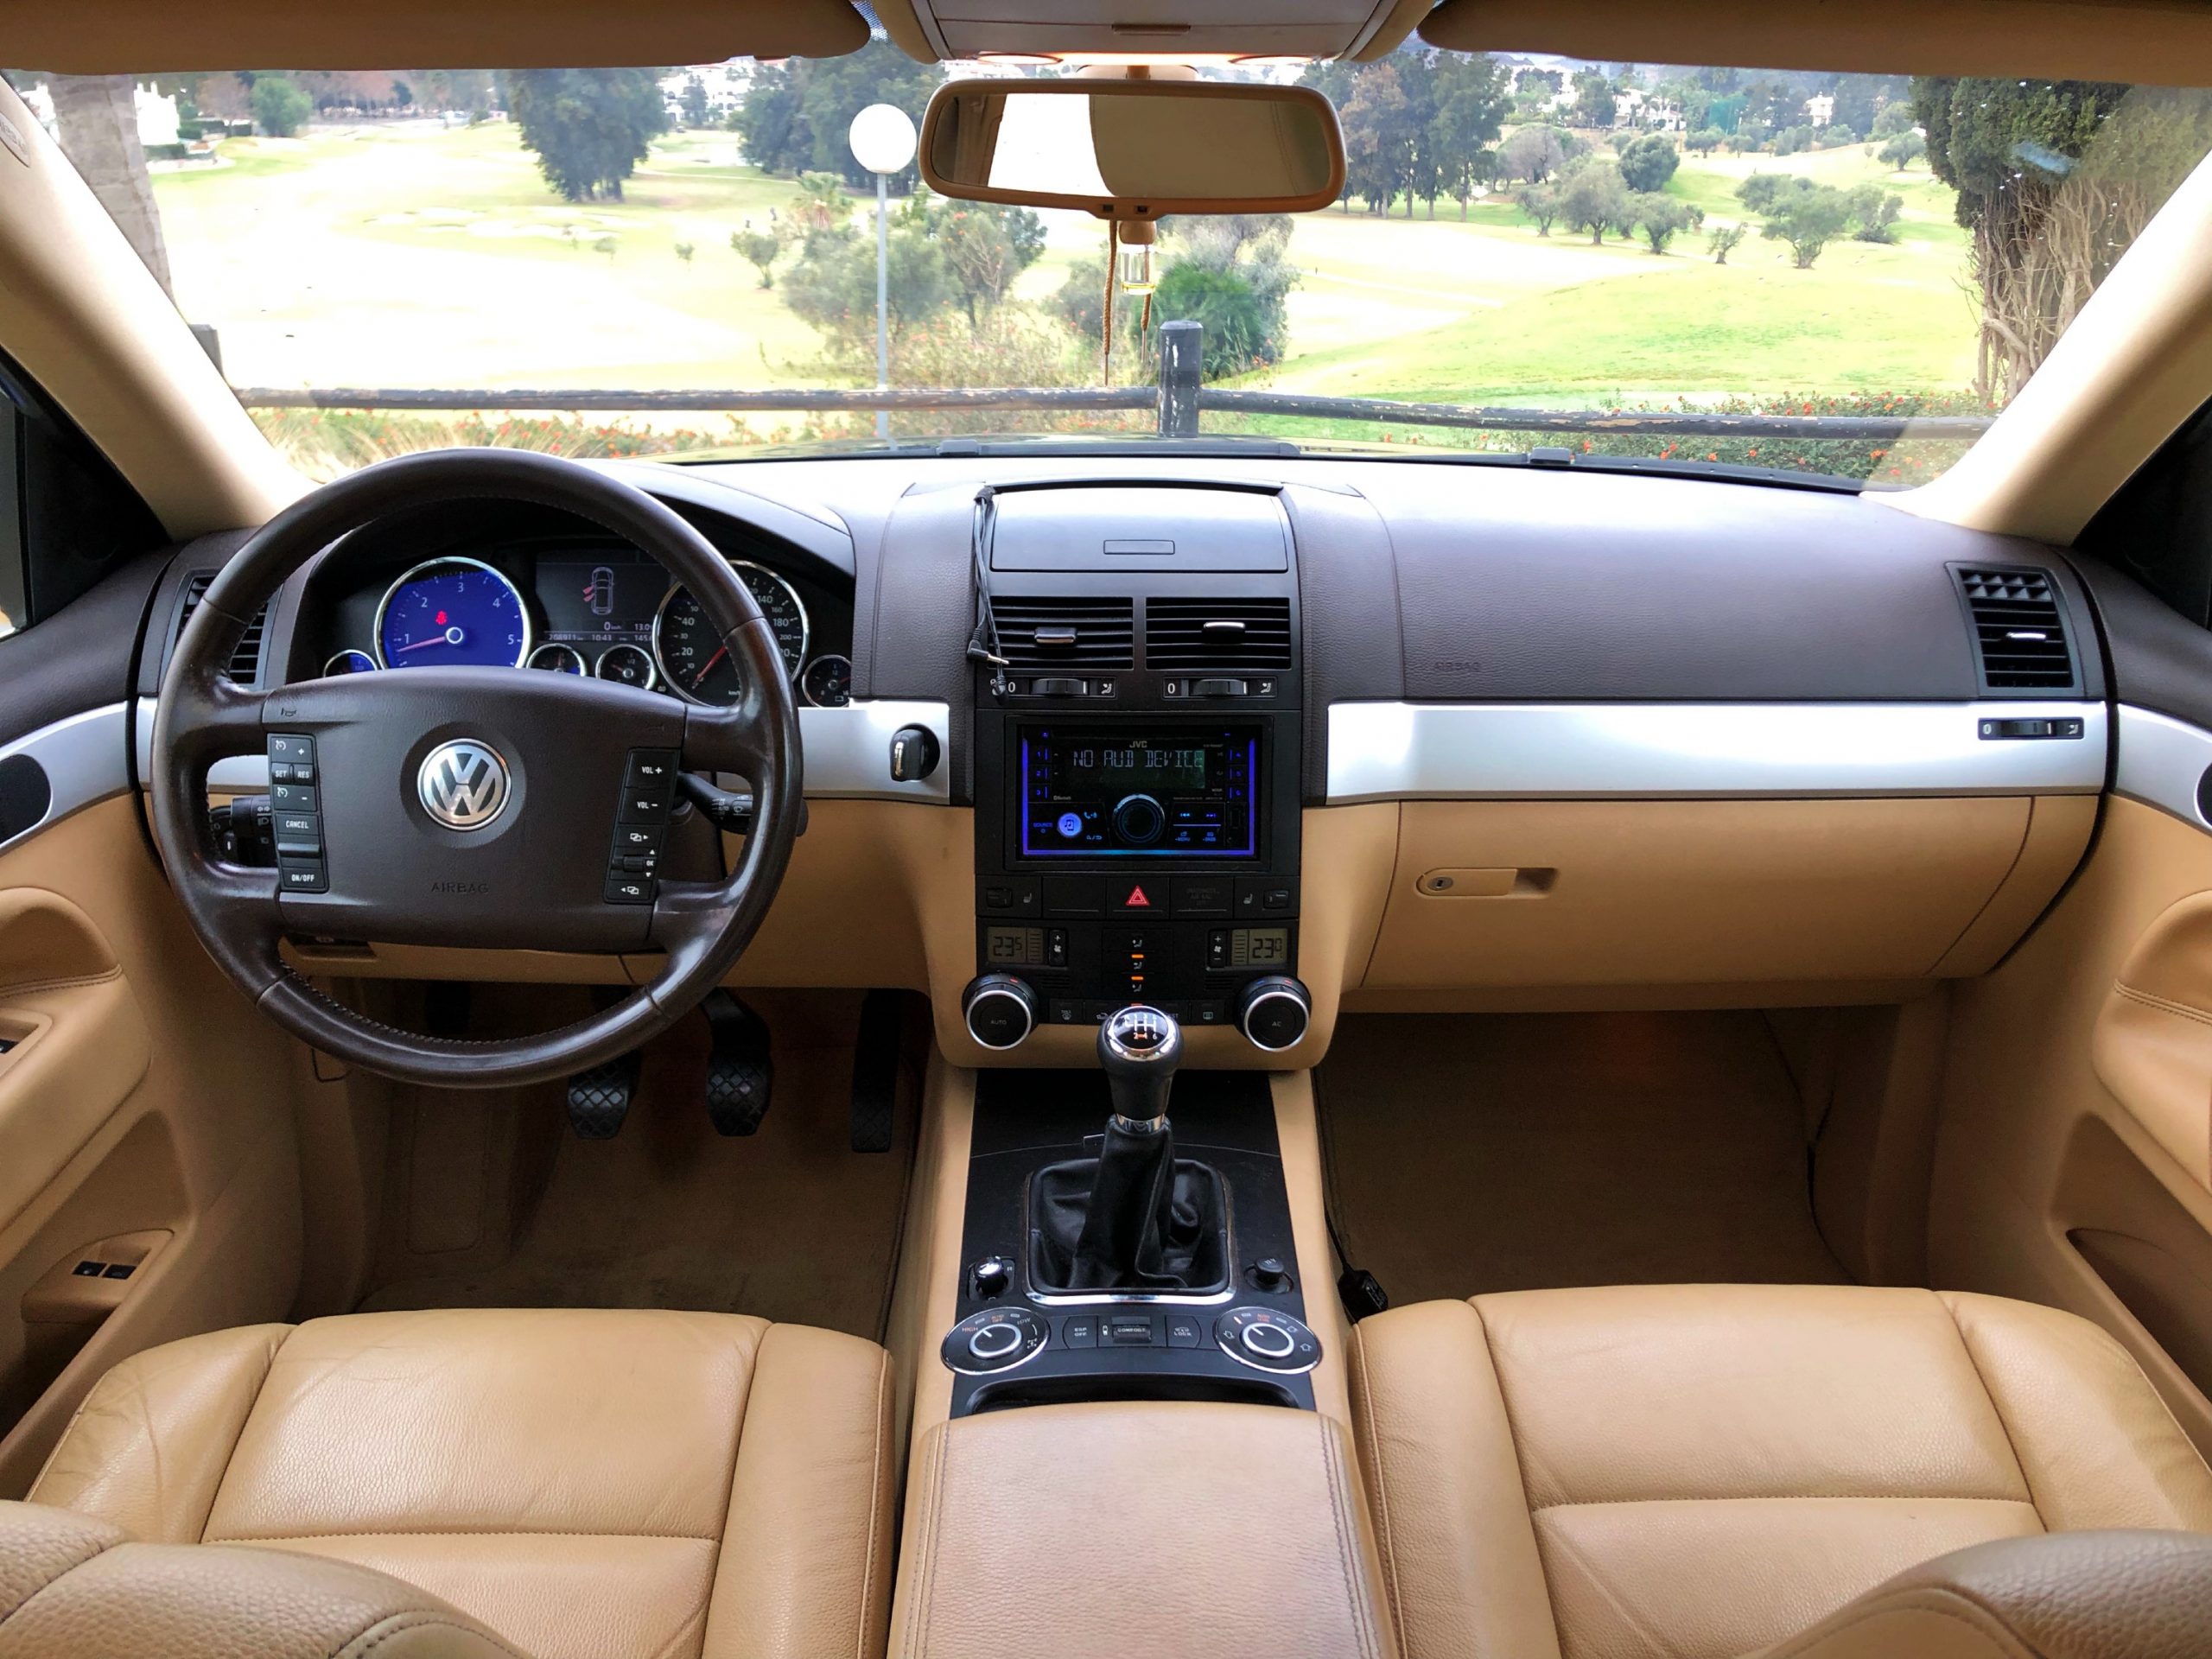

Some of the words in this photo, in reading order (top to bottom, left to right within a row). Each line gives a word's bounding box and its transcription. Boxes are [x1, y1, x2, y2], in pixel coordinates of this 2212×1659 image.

[458, 582, 464, 593] 3
[421, 597, 428, 607] 2
[493, 597, 500, 607] 4
[681, 617, 695, 626] 40
[772, 618, 789, 626] 180
[404, 633, 410, 644] 1
[507, 634, 514, 645] 5
[681, 647, 693, 656] 20
[1072, 749, 1094, 768] NO
[1144, 749, 1205, 768] DEVICE
[275, 770, 288, 779] SET
[297, 771, 310, 779] RES
[285, 820, 309, 830] CANCEL
[291, 874, 315, 882] ON/OFF
[431, 881, 489, 893] AIRBAG
